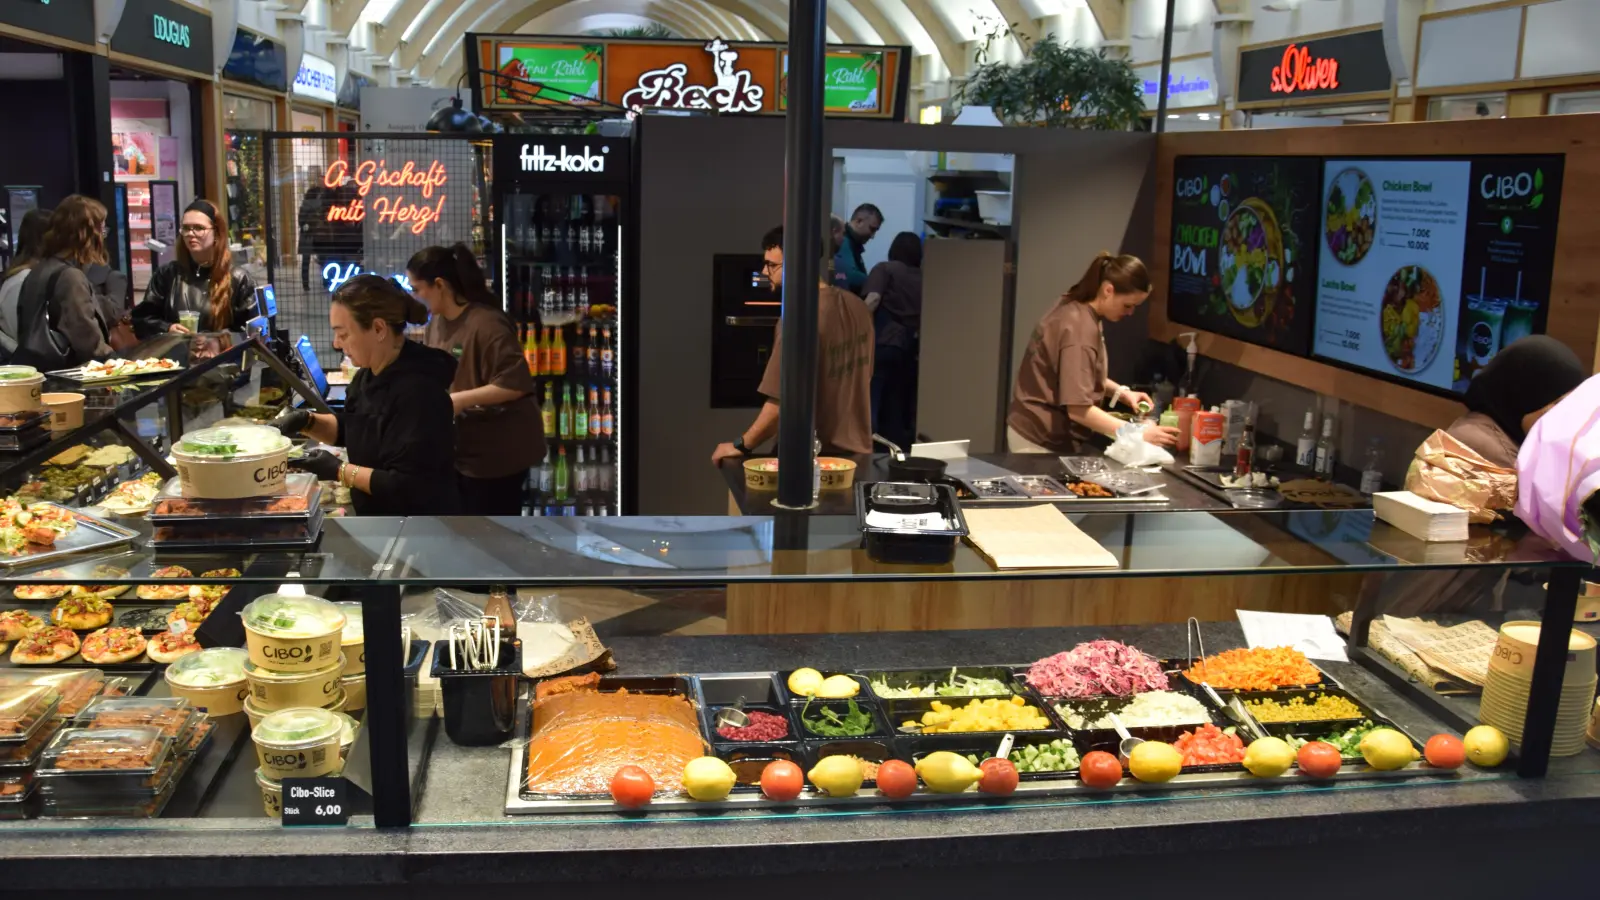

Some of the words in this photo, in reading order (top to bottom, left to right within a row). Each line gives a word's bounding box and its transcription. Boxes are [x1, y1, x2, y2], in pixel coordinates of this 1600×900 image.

[153, 14, 190, 48] DOUGLAS
[1271, 43, 1339, 93] s.Oliver
[622, 63, 764, 116] Beck
[325, 160, 348, 187] A
[355, 160, 447, 198] G'schaft
[1176, 177, 1202, 197] CIBO
[1382, 180, 1412, 192] Chicken
[1481, 172, 1532, 199] CIBO
[327, 199, 366, 222] mit
[373, 195, 446, 235] Herz!
[254, 460, 287, 483] CIBO
[263, 645, 303, 660] CIBO
[263, 752, 297, 766] CIBO
[290, 786, 335, 798] Cibo-Slice
[284, 807, 300, 815] Stück
[315, 804, 342, 817] 6,00
